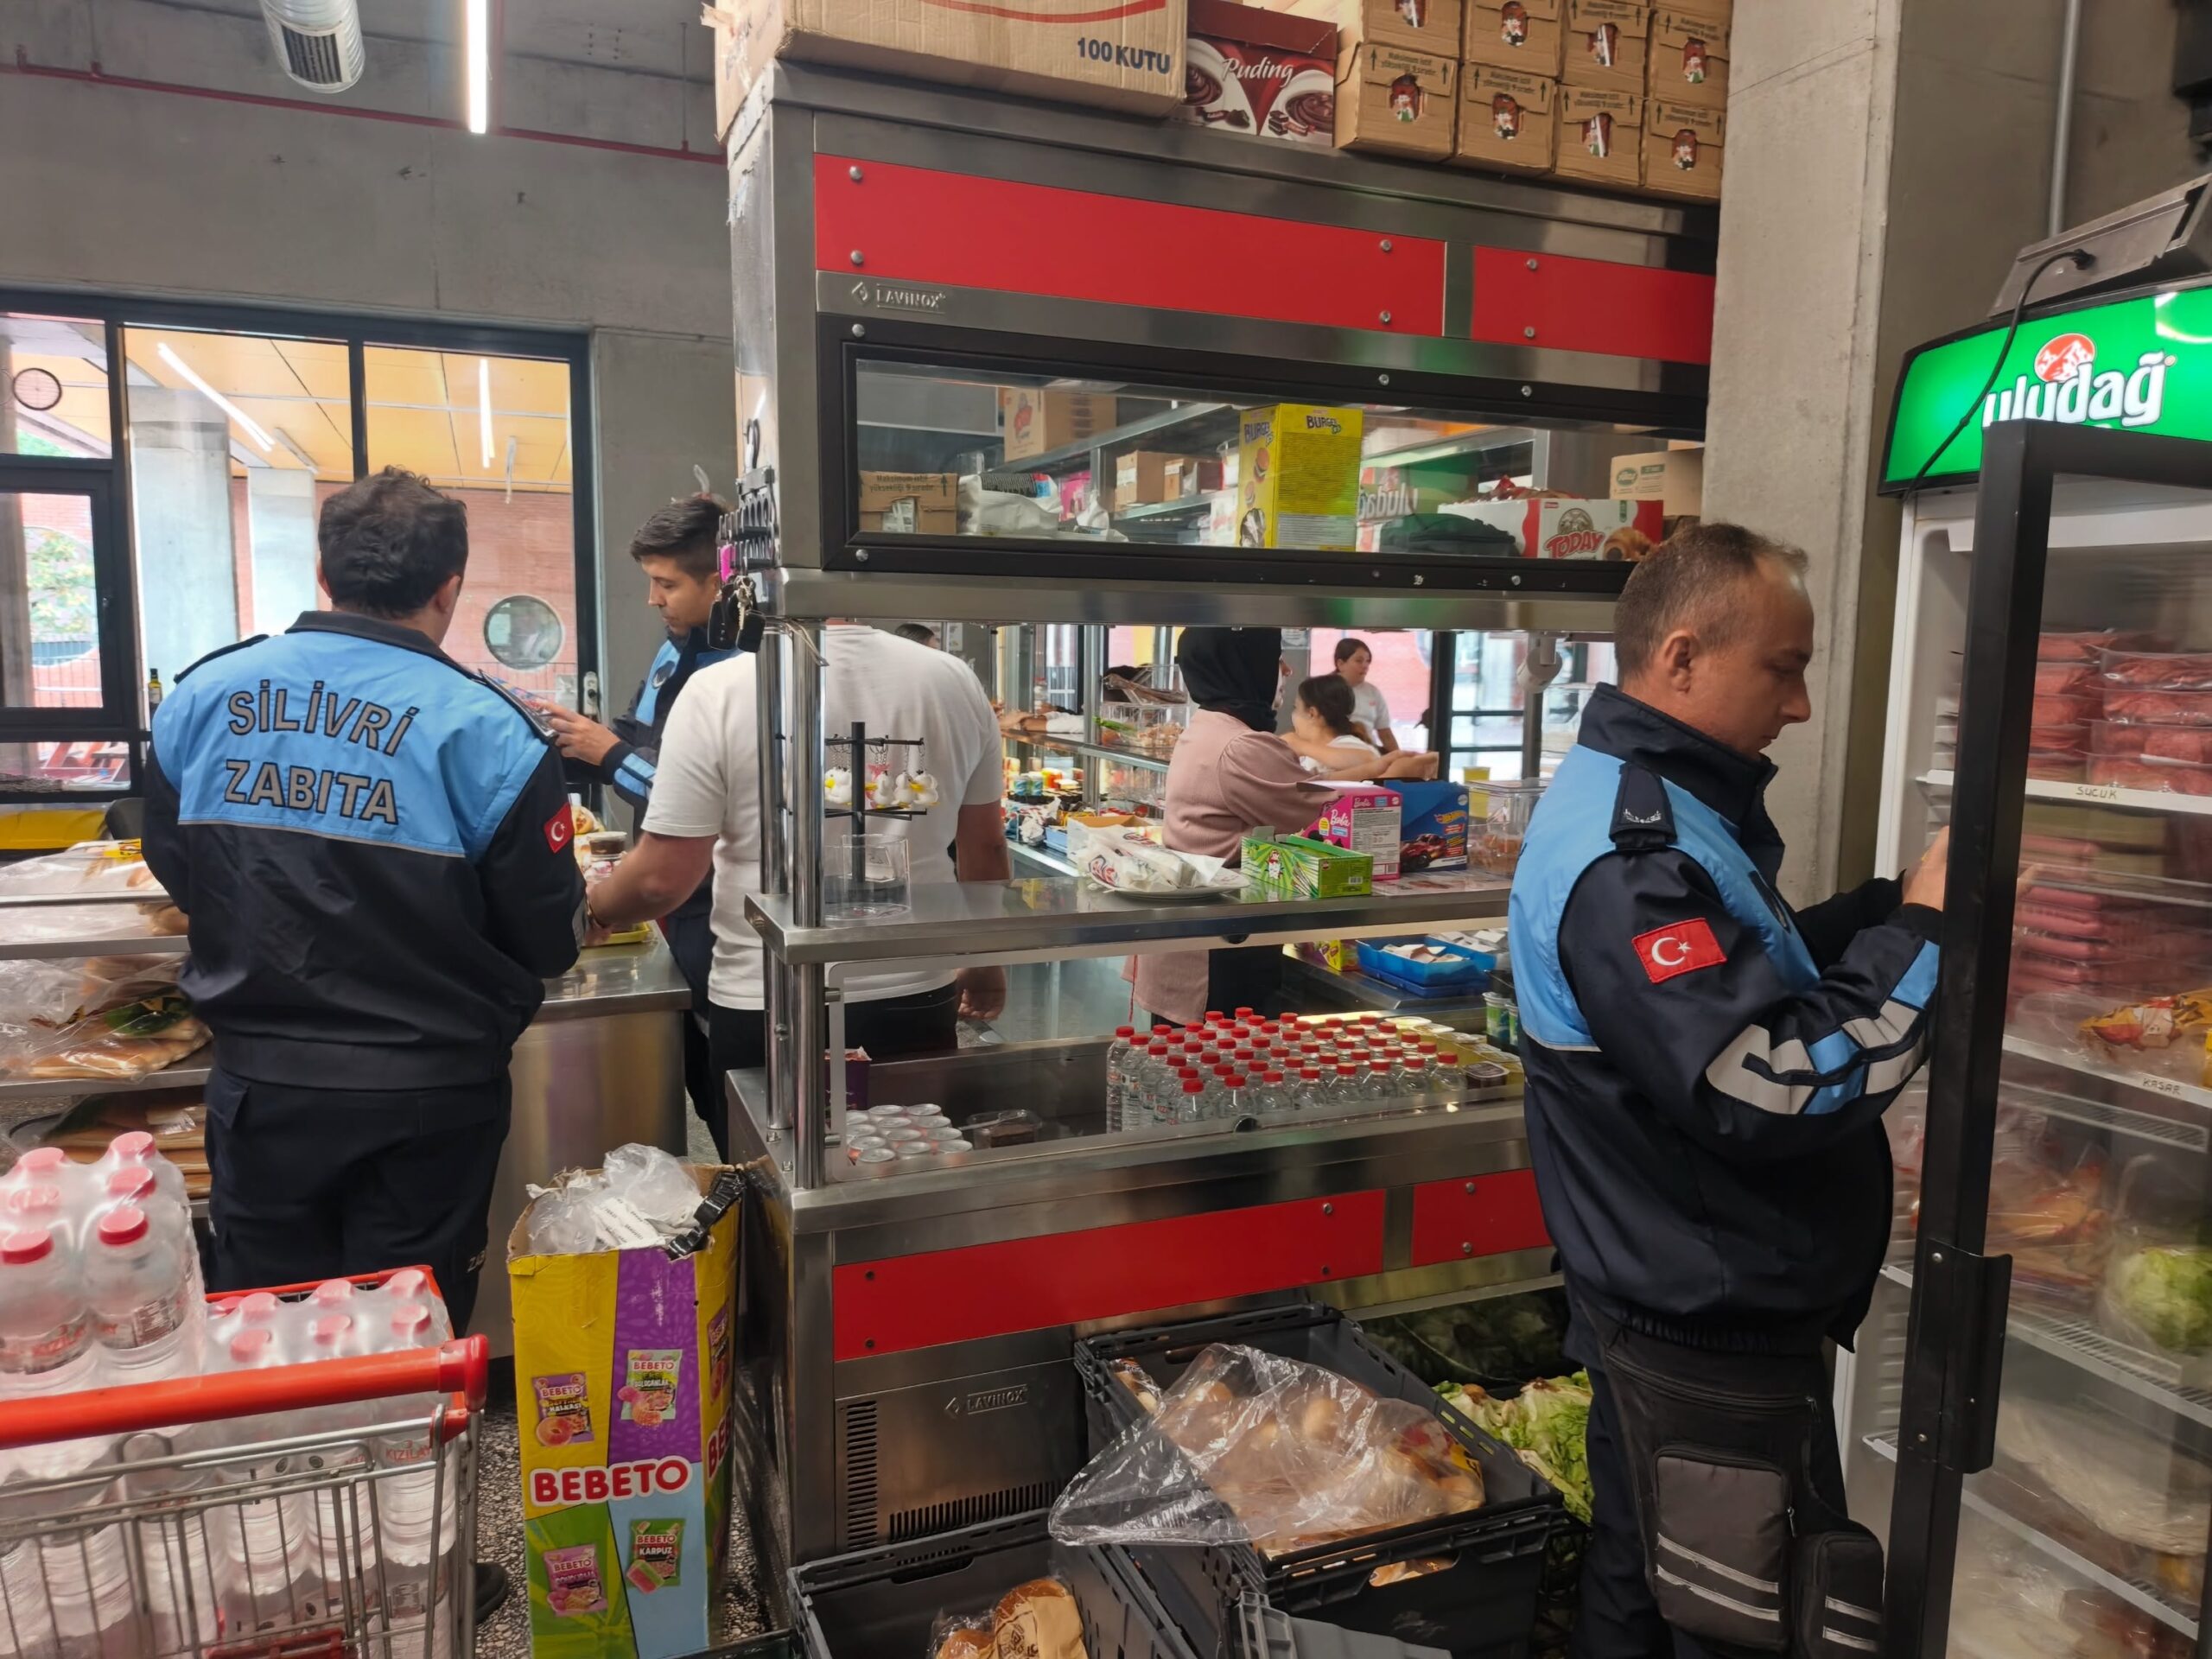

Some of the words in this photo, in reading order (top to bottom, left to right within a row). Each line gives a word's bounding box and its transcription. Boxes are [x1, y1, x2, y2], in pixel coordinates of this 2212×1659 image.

[1077, 37, 1113, 63] 100
[1116, 45, 1171, 74] KUTU
[1222, 56, 1295, 88] Puding
[1981, 350, 2169, 428] uludağ
[1546, 531, 1605, 559] TODAY
[225, 760, 399, 825] ZABITA
[633, 1360, 675, 1370] BEBETO
[542, 1386, 582, 1398] BEBETO
[534, 1459, 689, 1503] BEBETO
[638, 1535, 677, 1544] BEBETO
[639, 1547, 673, 1555] KARPUZ
[554, 1560, 592, 1573] BEBETO
